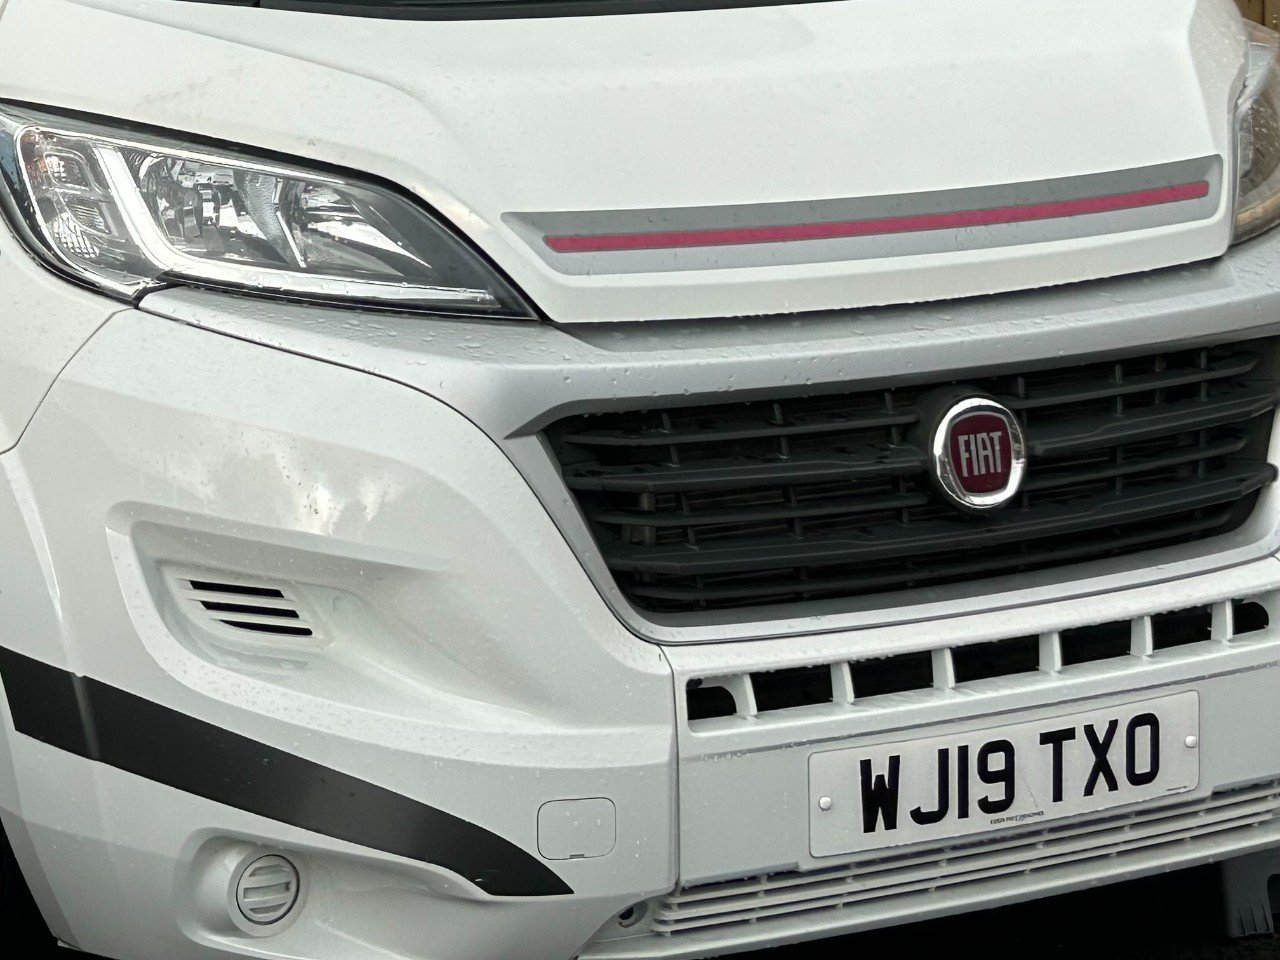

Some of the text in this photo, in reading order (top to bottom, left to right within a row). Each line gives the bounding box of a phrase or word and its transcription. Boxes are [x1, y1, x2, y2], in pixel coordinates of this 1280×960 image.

[957, 431, 1002, 478] FIAT
[859, 712, 1160, 833] WJ19 TXO
